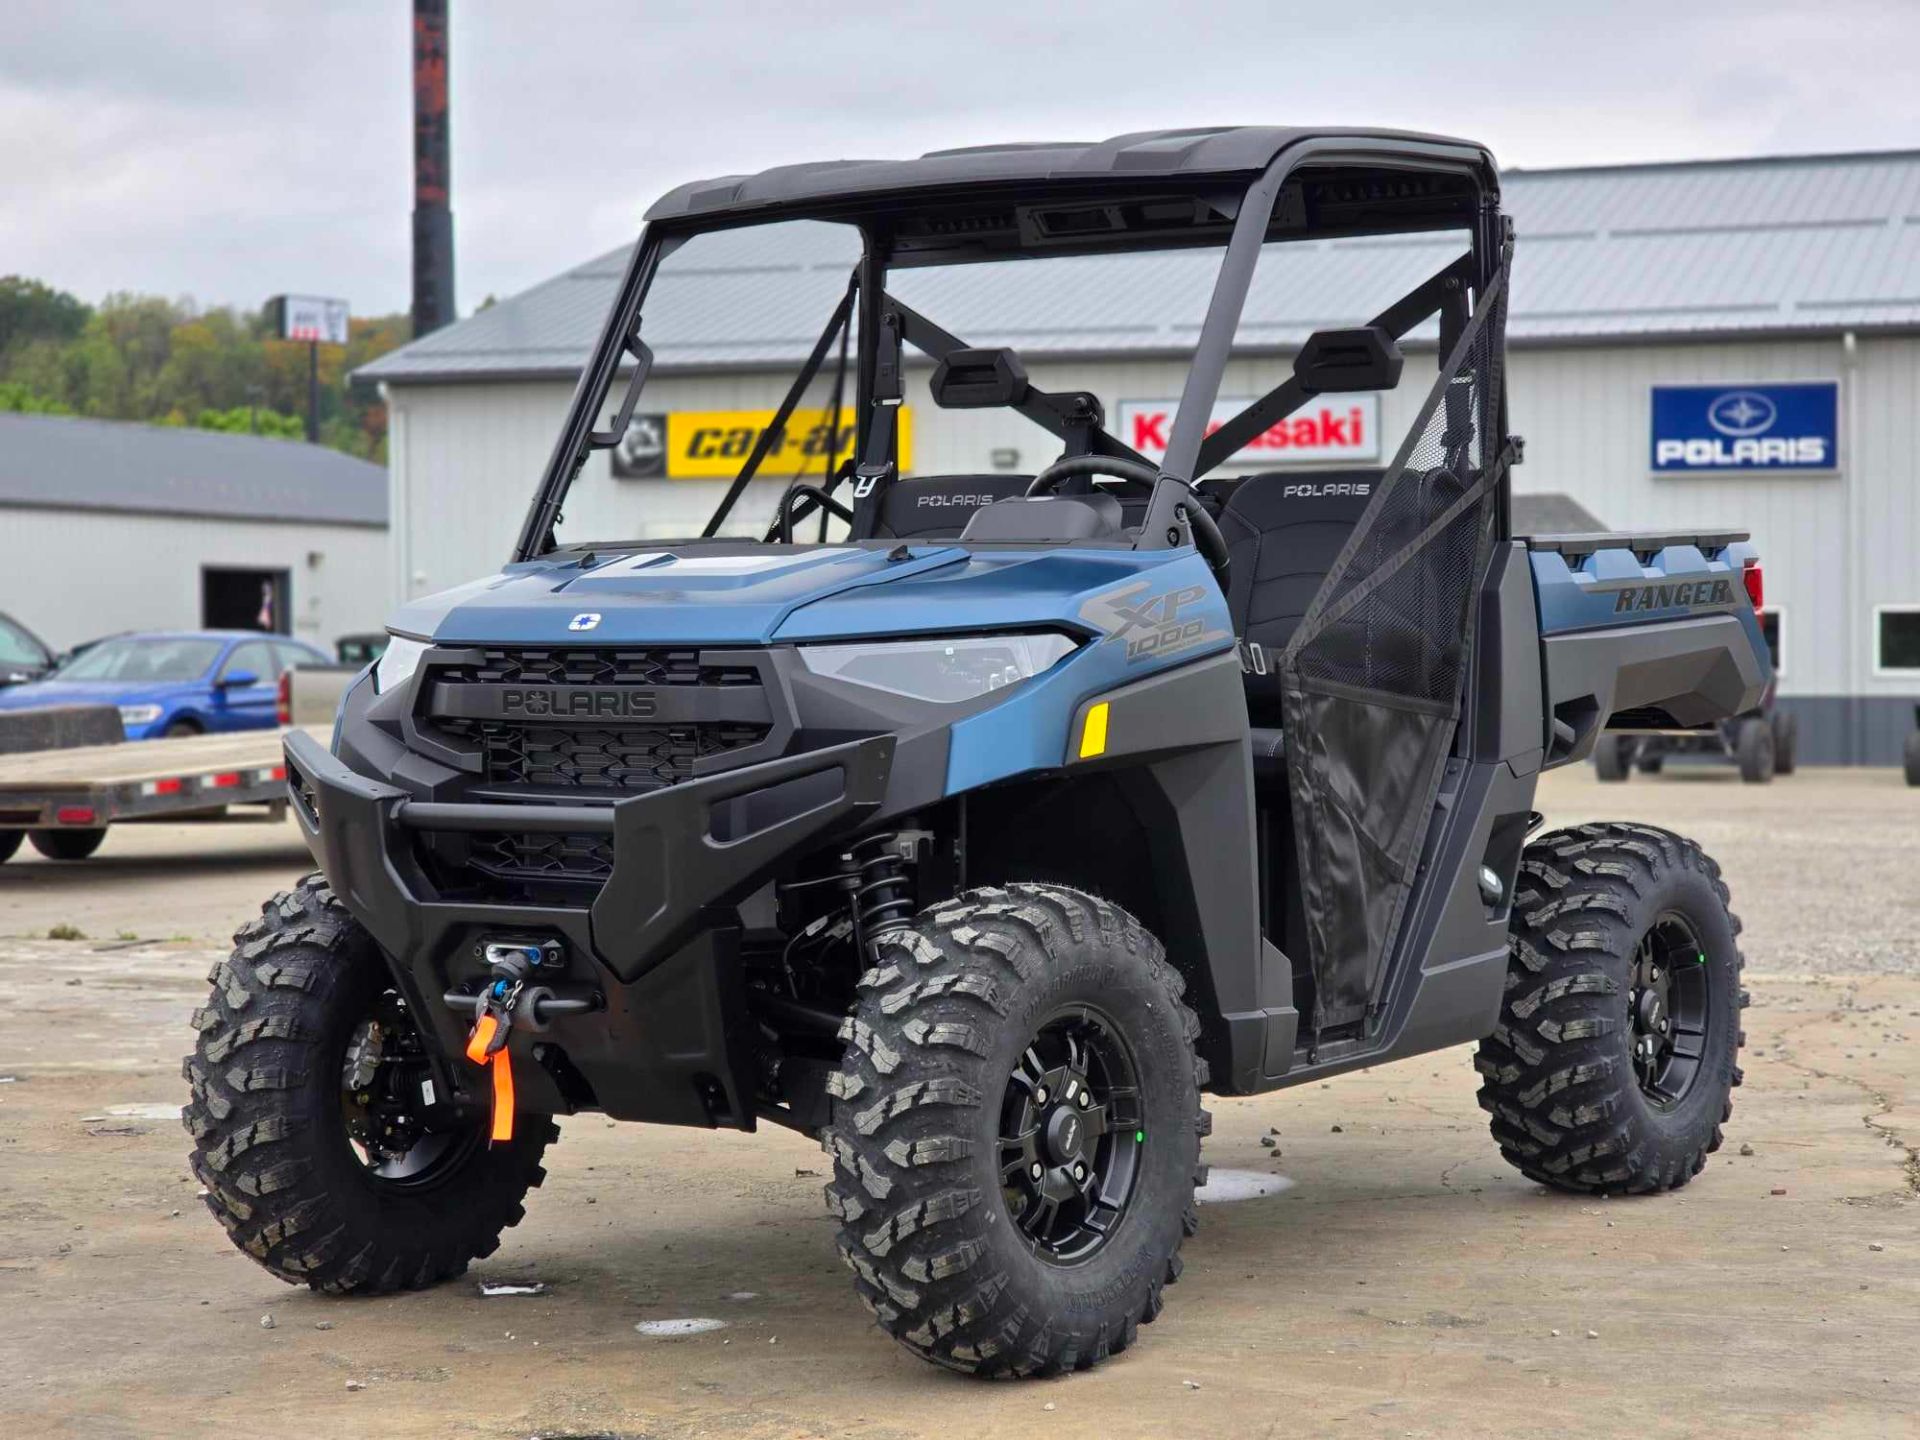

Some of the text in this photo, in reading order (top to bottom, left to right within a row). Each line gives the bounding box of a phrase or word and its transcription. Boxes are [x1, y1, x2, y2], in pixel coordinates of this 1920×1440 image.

[1133, 409, 1363, 450] Ksaki
[1656, 437, 1826, 466] POLARIS
[917, 494, 994, 508] POLARIS
[1283, 484, 1370, 498] POLARIS
[1614, 579, 1736, 613] RANGER
[1106, 584, 1207, 642] XP
[1127, 620, 1206, 658] 1000
[502, 689, 658, 717] POLARIS
